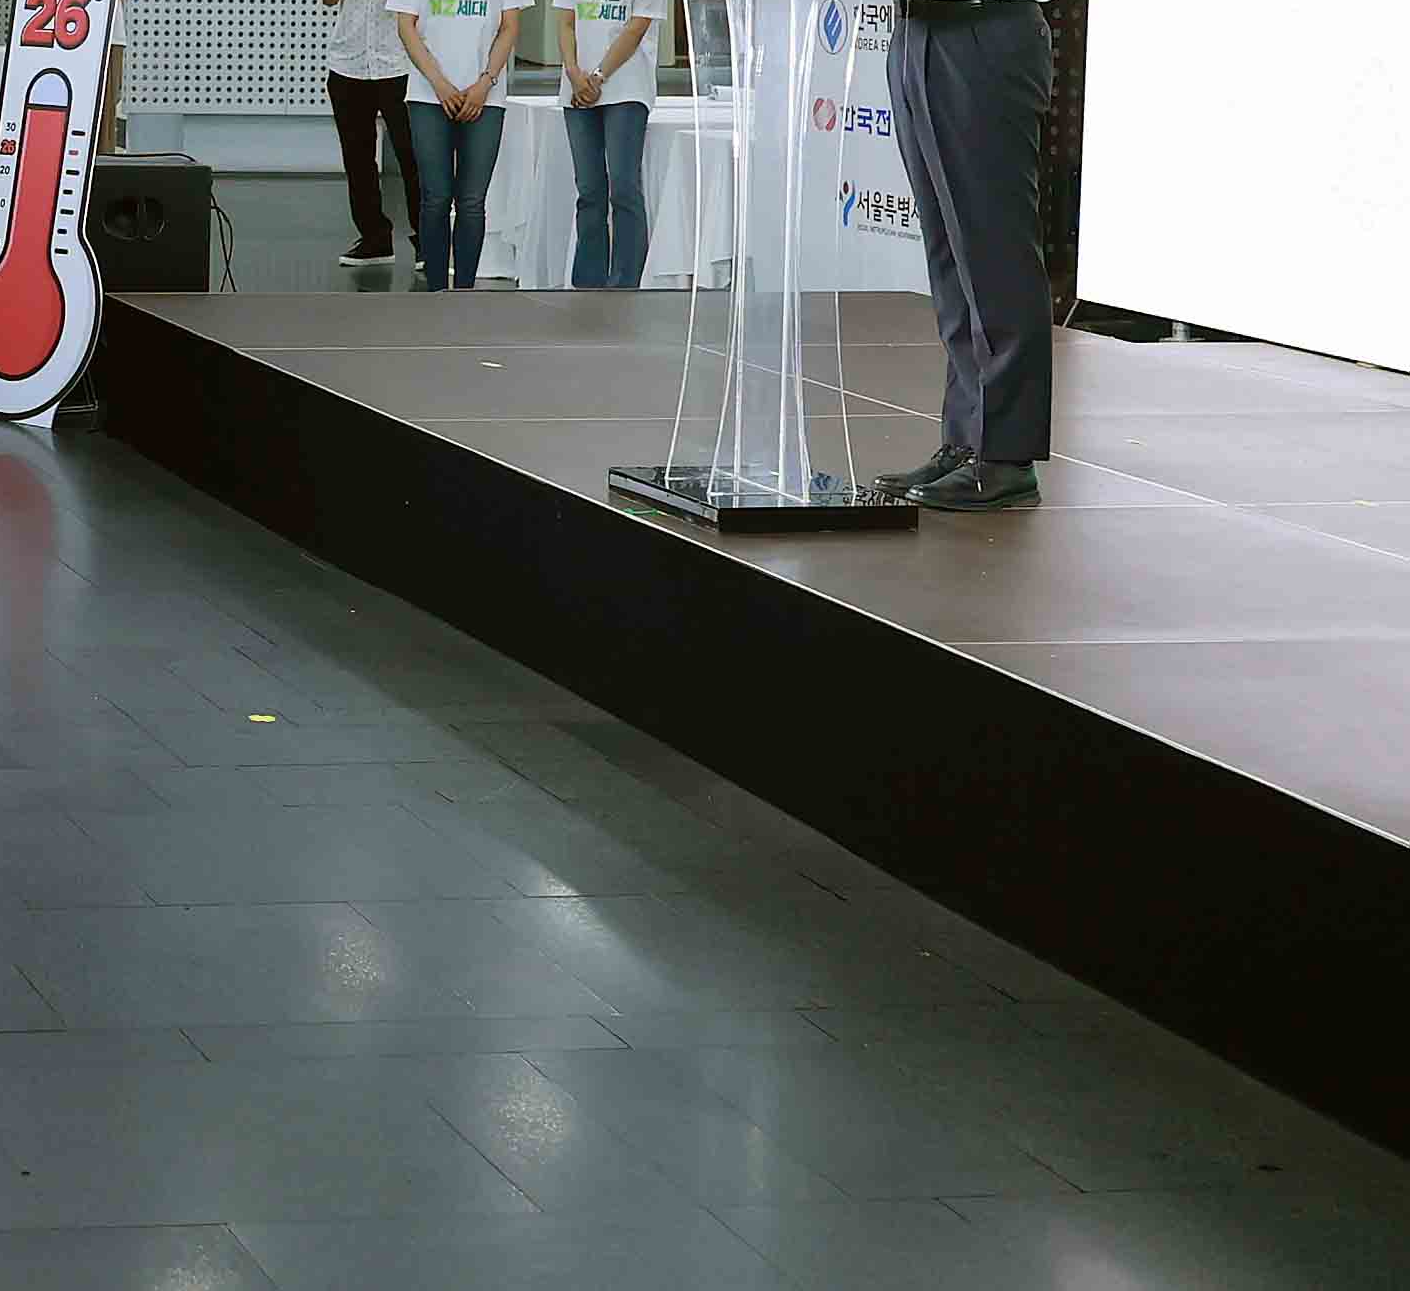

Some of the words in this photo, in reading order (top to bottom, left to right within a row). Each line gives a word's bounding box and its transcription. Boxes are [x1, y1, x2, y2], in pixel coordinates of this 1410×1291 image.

[856, 37, 879, 52] OREA
[5, 122, 16, 132] 30
[0, 139, 16, 155] 26
[0, 165, 10, 175] 20
